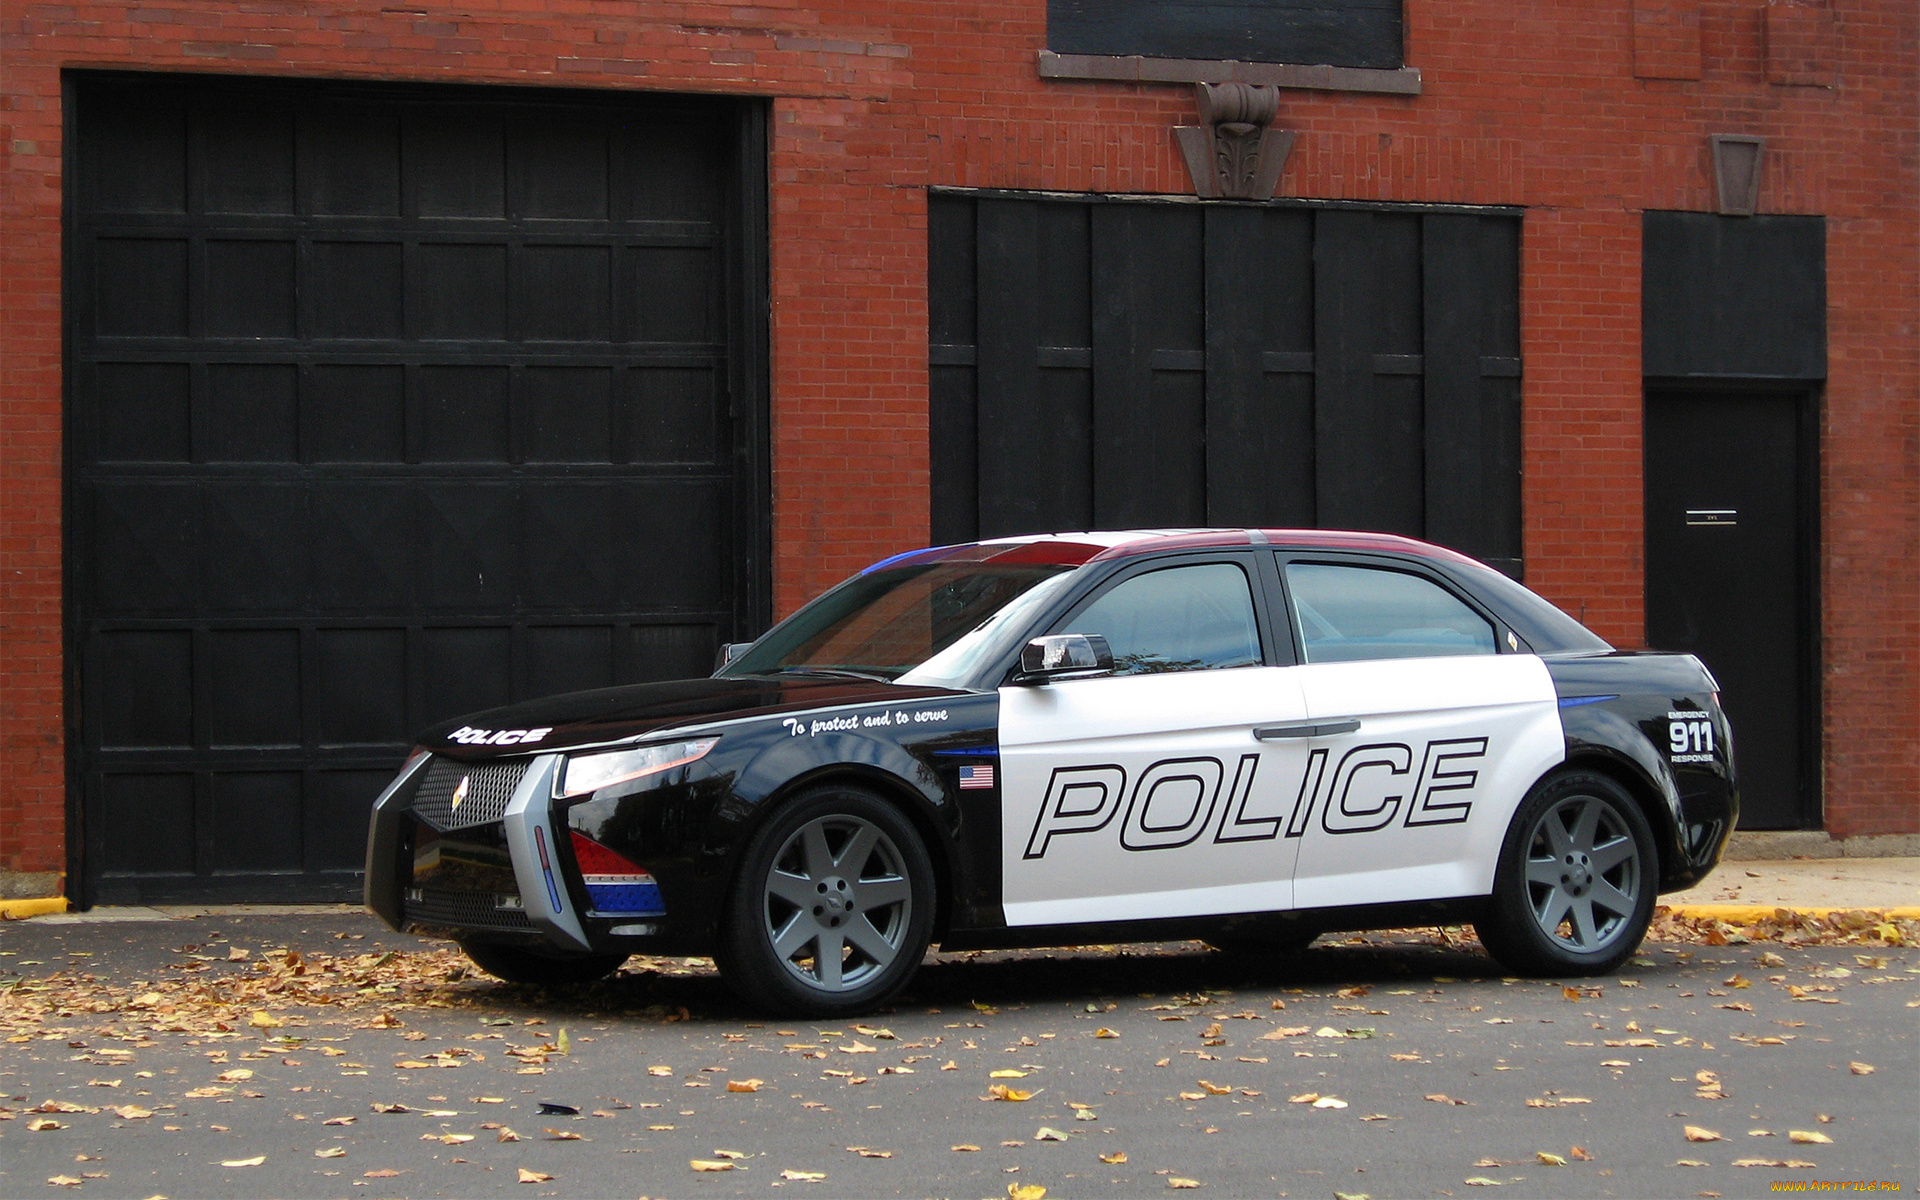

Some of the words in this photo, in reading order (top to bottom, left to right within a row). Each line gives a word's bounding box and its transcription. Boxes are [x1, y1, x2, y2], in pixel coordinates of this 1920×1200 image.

[782, 717, 806, 737] To
[810, 715, 859, 738] protect
[863, 710, 891, 728] and
[895, 710, 910, 725] to
[914, 709, 949, 723] serve
[1668, 710, 1710, 719] EMERGENCY
[447, 726, 553, 745] POLICE
[1669, 721, 1713, 752] 911
[1671, 754, 1714, 763] RESPONSE
[1022, 736, 1489, 860] POLICE
